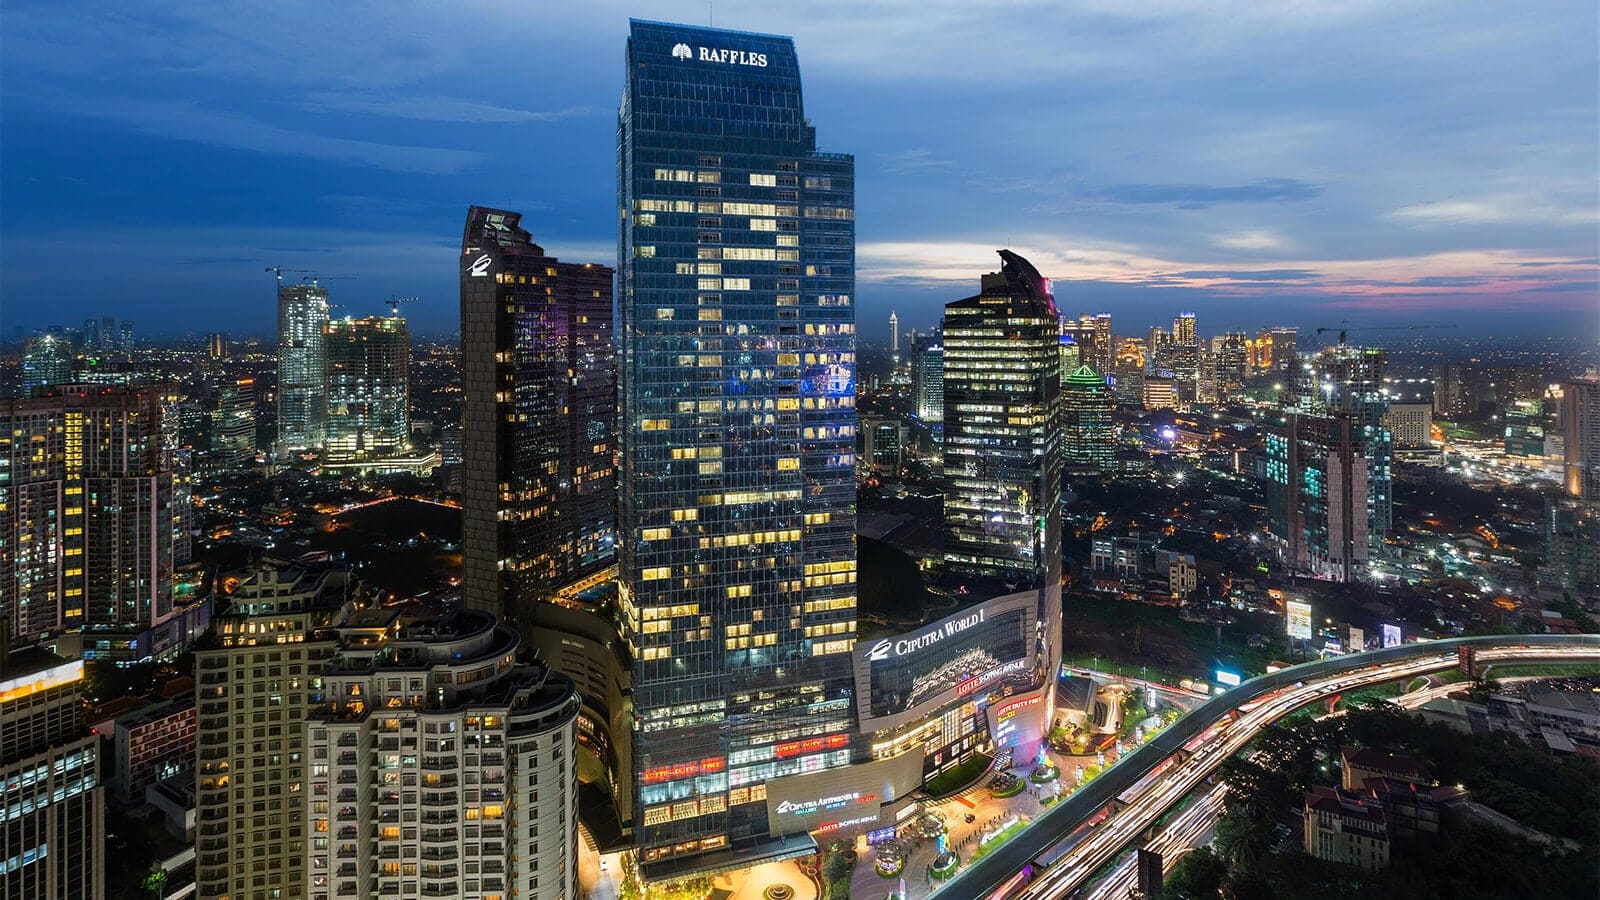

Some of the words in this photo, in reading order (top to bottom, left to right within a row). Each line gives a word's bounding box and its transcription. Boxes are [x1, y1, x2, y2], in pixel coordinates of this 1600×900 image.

[699, 47, 767, 67] RAFFLES
[895, 629, 944, 655] CIPUTRA
[945, 614, 978, 636] WORLD
[958, 680, 978, 695] LOTTE
[820, 823, 838, 832] LOTTE
